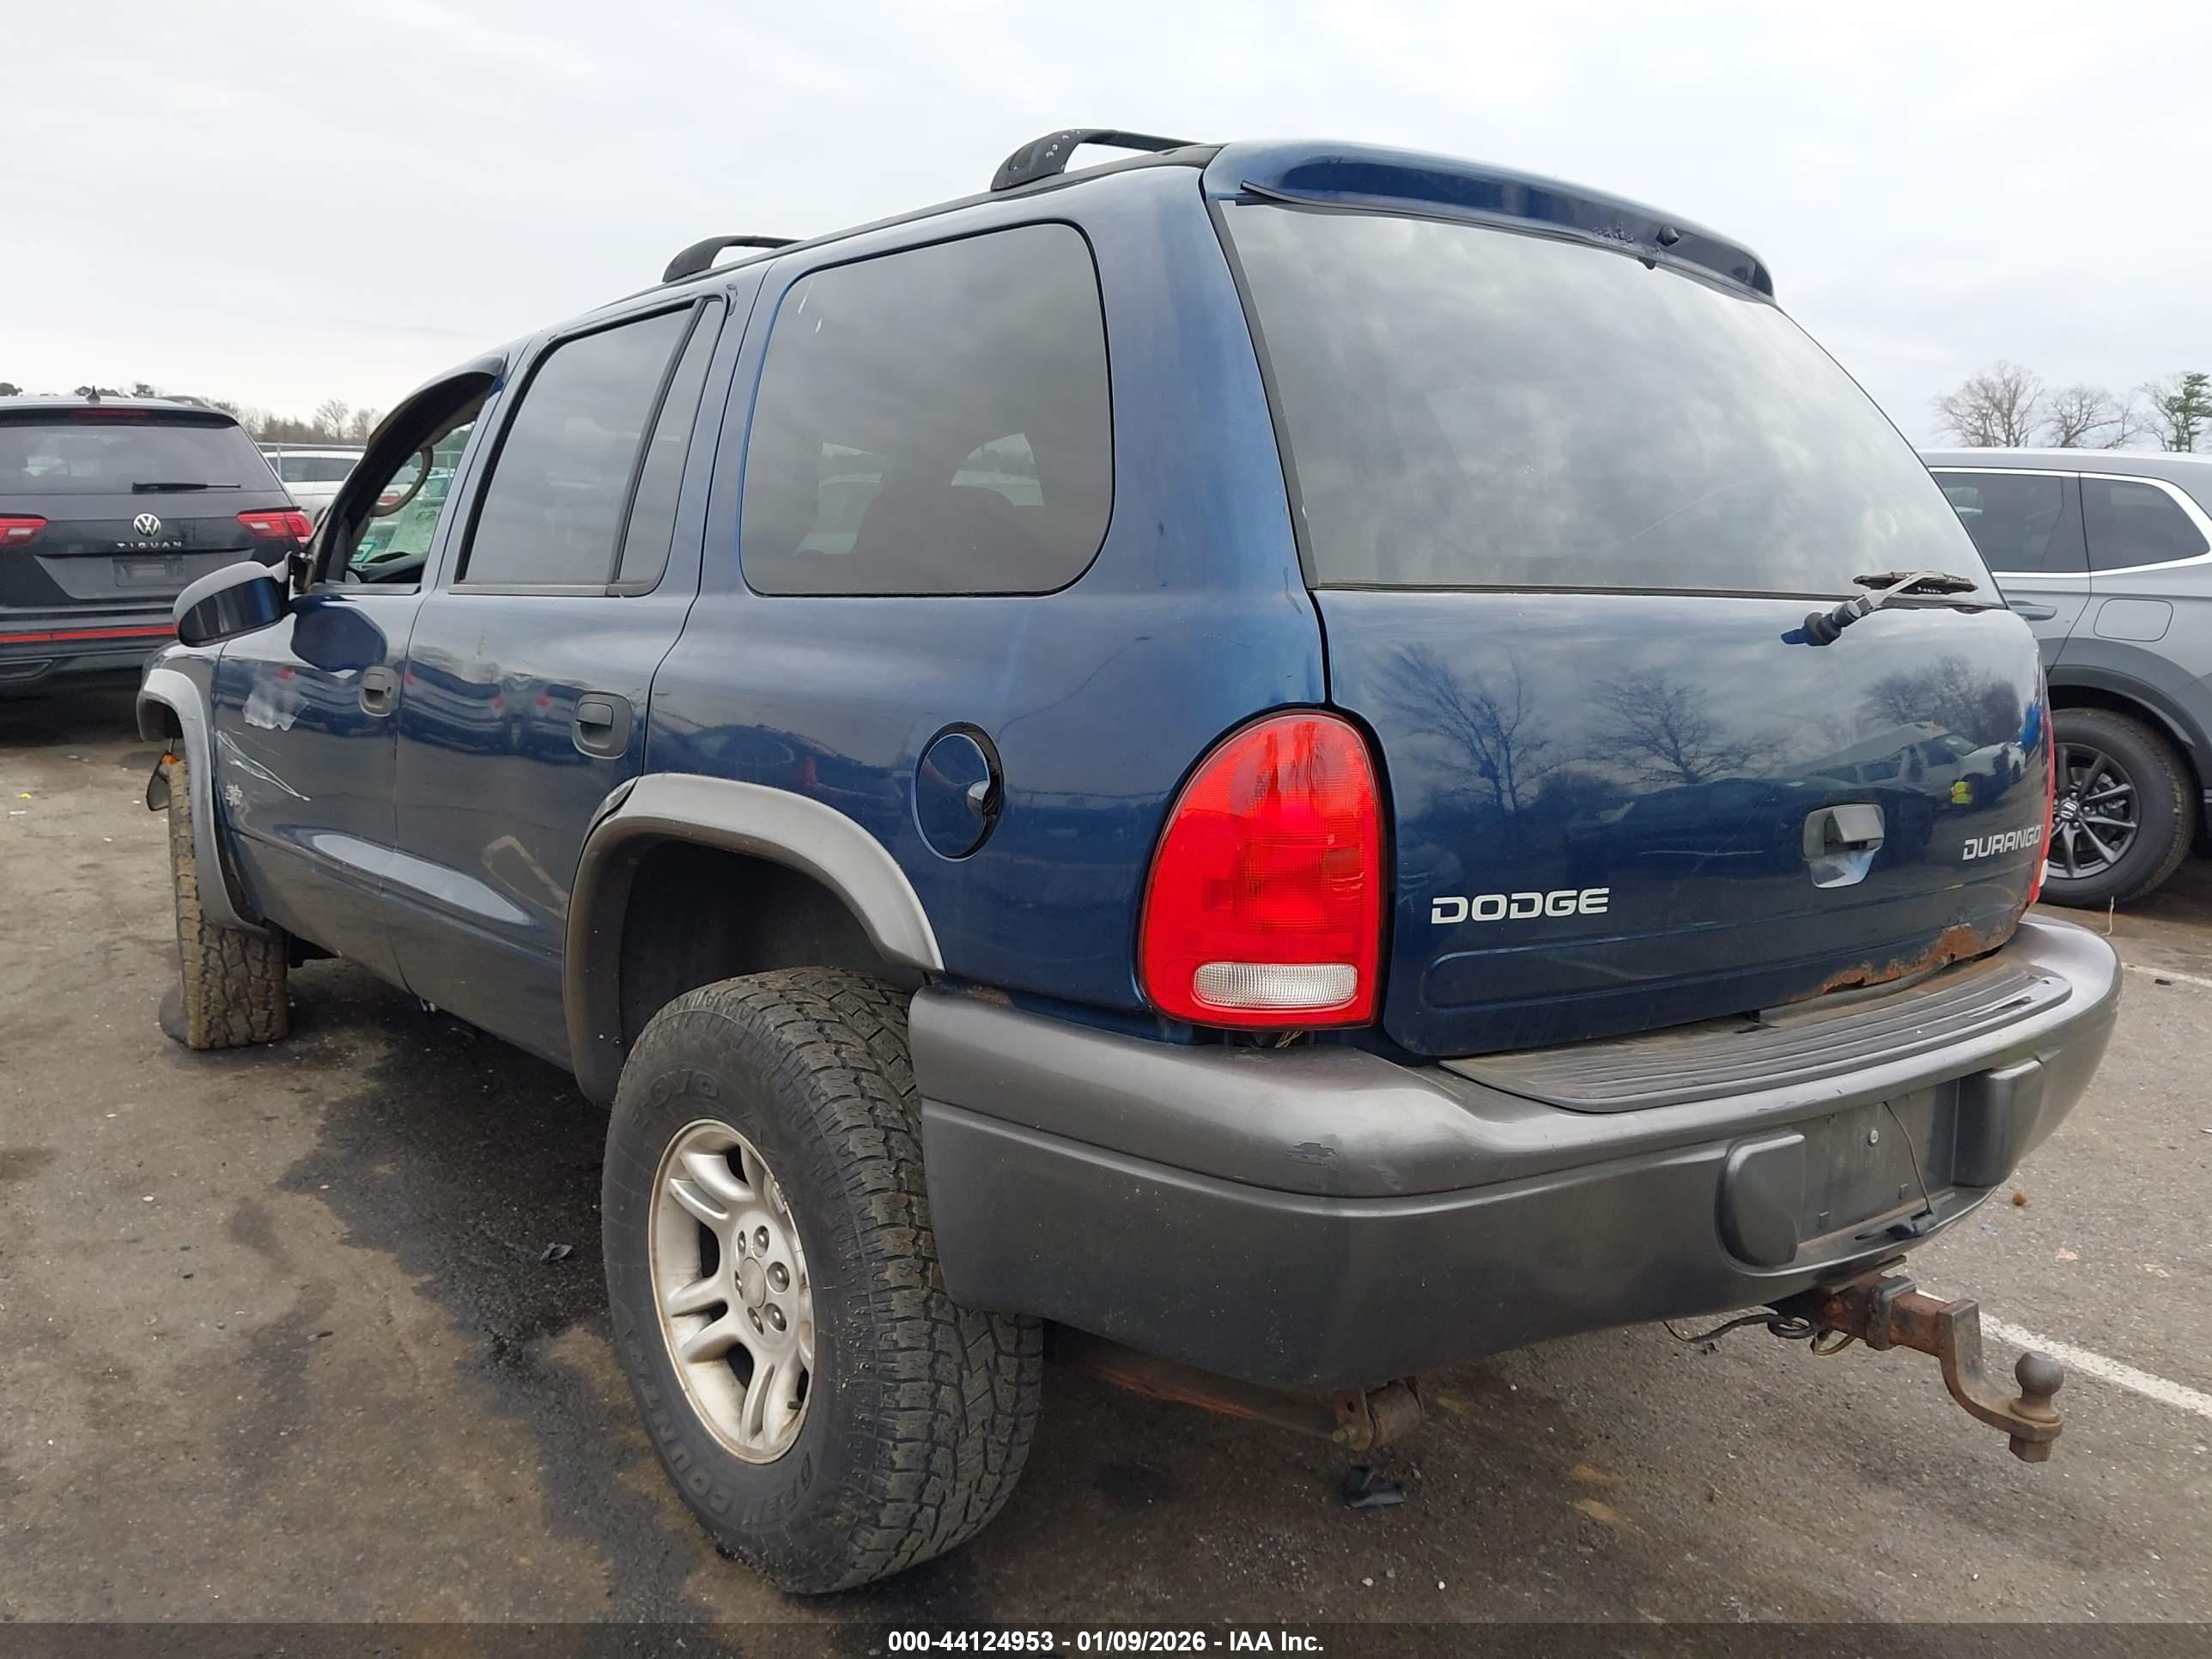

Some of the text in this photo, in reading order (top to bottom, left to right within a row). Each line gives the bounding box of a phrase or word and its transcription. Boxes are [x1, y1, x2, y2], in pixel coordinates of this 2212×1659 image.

[133, 513, 161, 538] VW
[1962, 824, 2042, 860] DURANGO
[1431, 887, 1610, 924] DODGE
